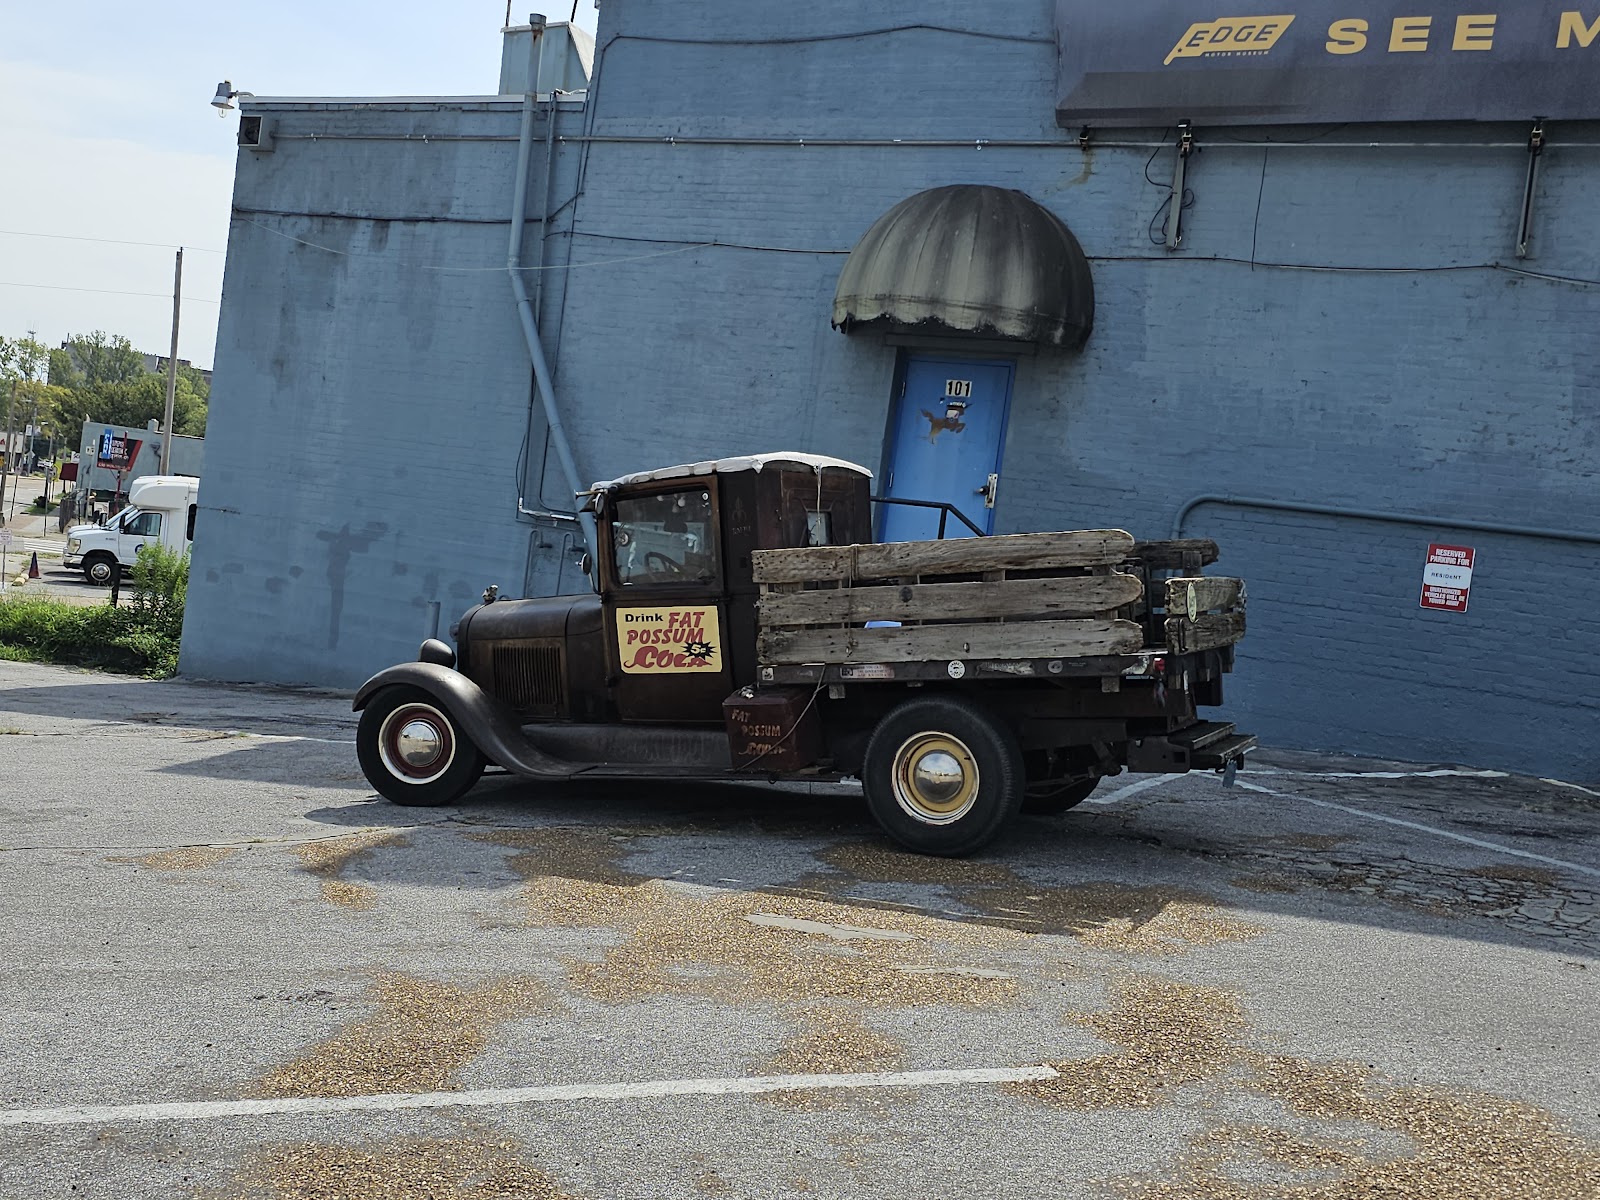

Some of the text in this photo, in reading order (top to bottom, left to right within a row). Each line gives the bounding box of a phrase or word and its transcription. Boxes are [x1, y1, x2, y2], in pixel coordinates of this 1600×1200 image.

[1185, 24, 1278, 47] EDGE
[1325, 14, 1497, 55] SEE
[947, 380, 971, 397] 101
[1430, 555, 1456, 564] PARKING
[1436, 548, 1466, 557] RESERVED
[625, 611, 705, 629] Drink FAT
[627, 628, 704, 645] POSSUM
[731, 708, 752, 723] FAT
[740, 724, 781, 737] POSSUM
